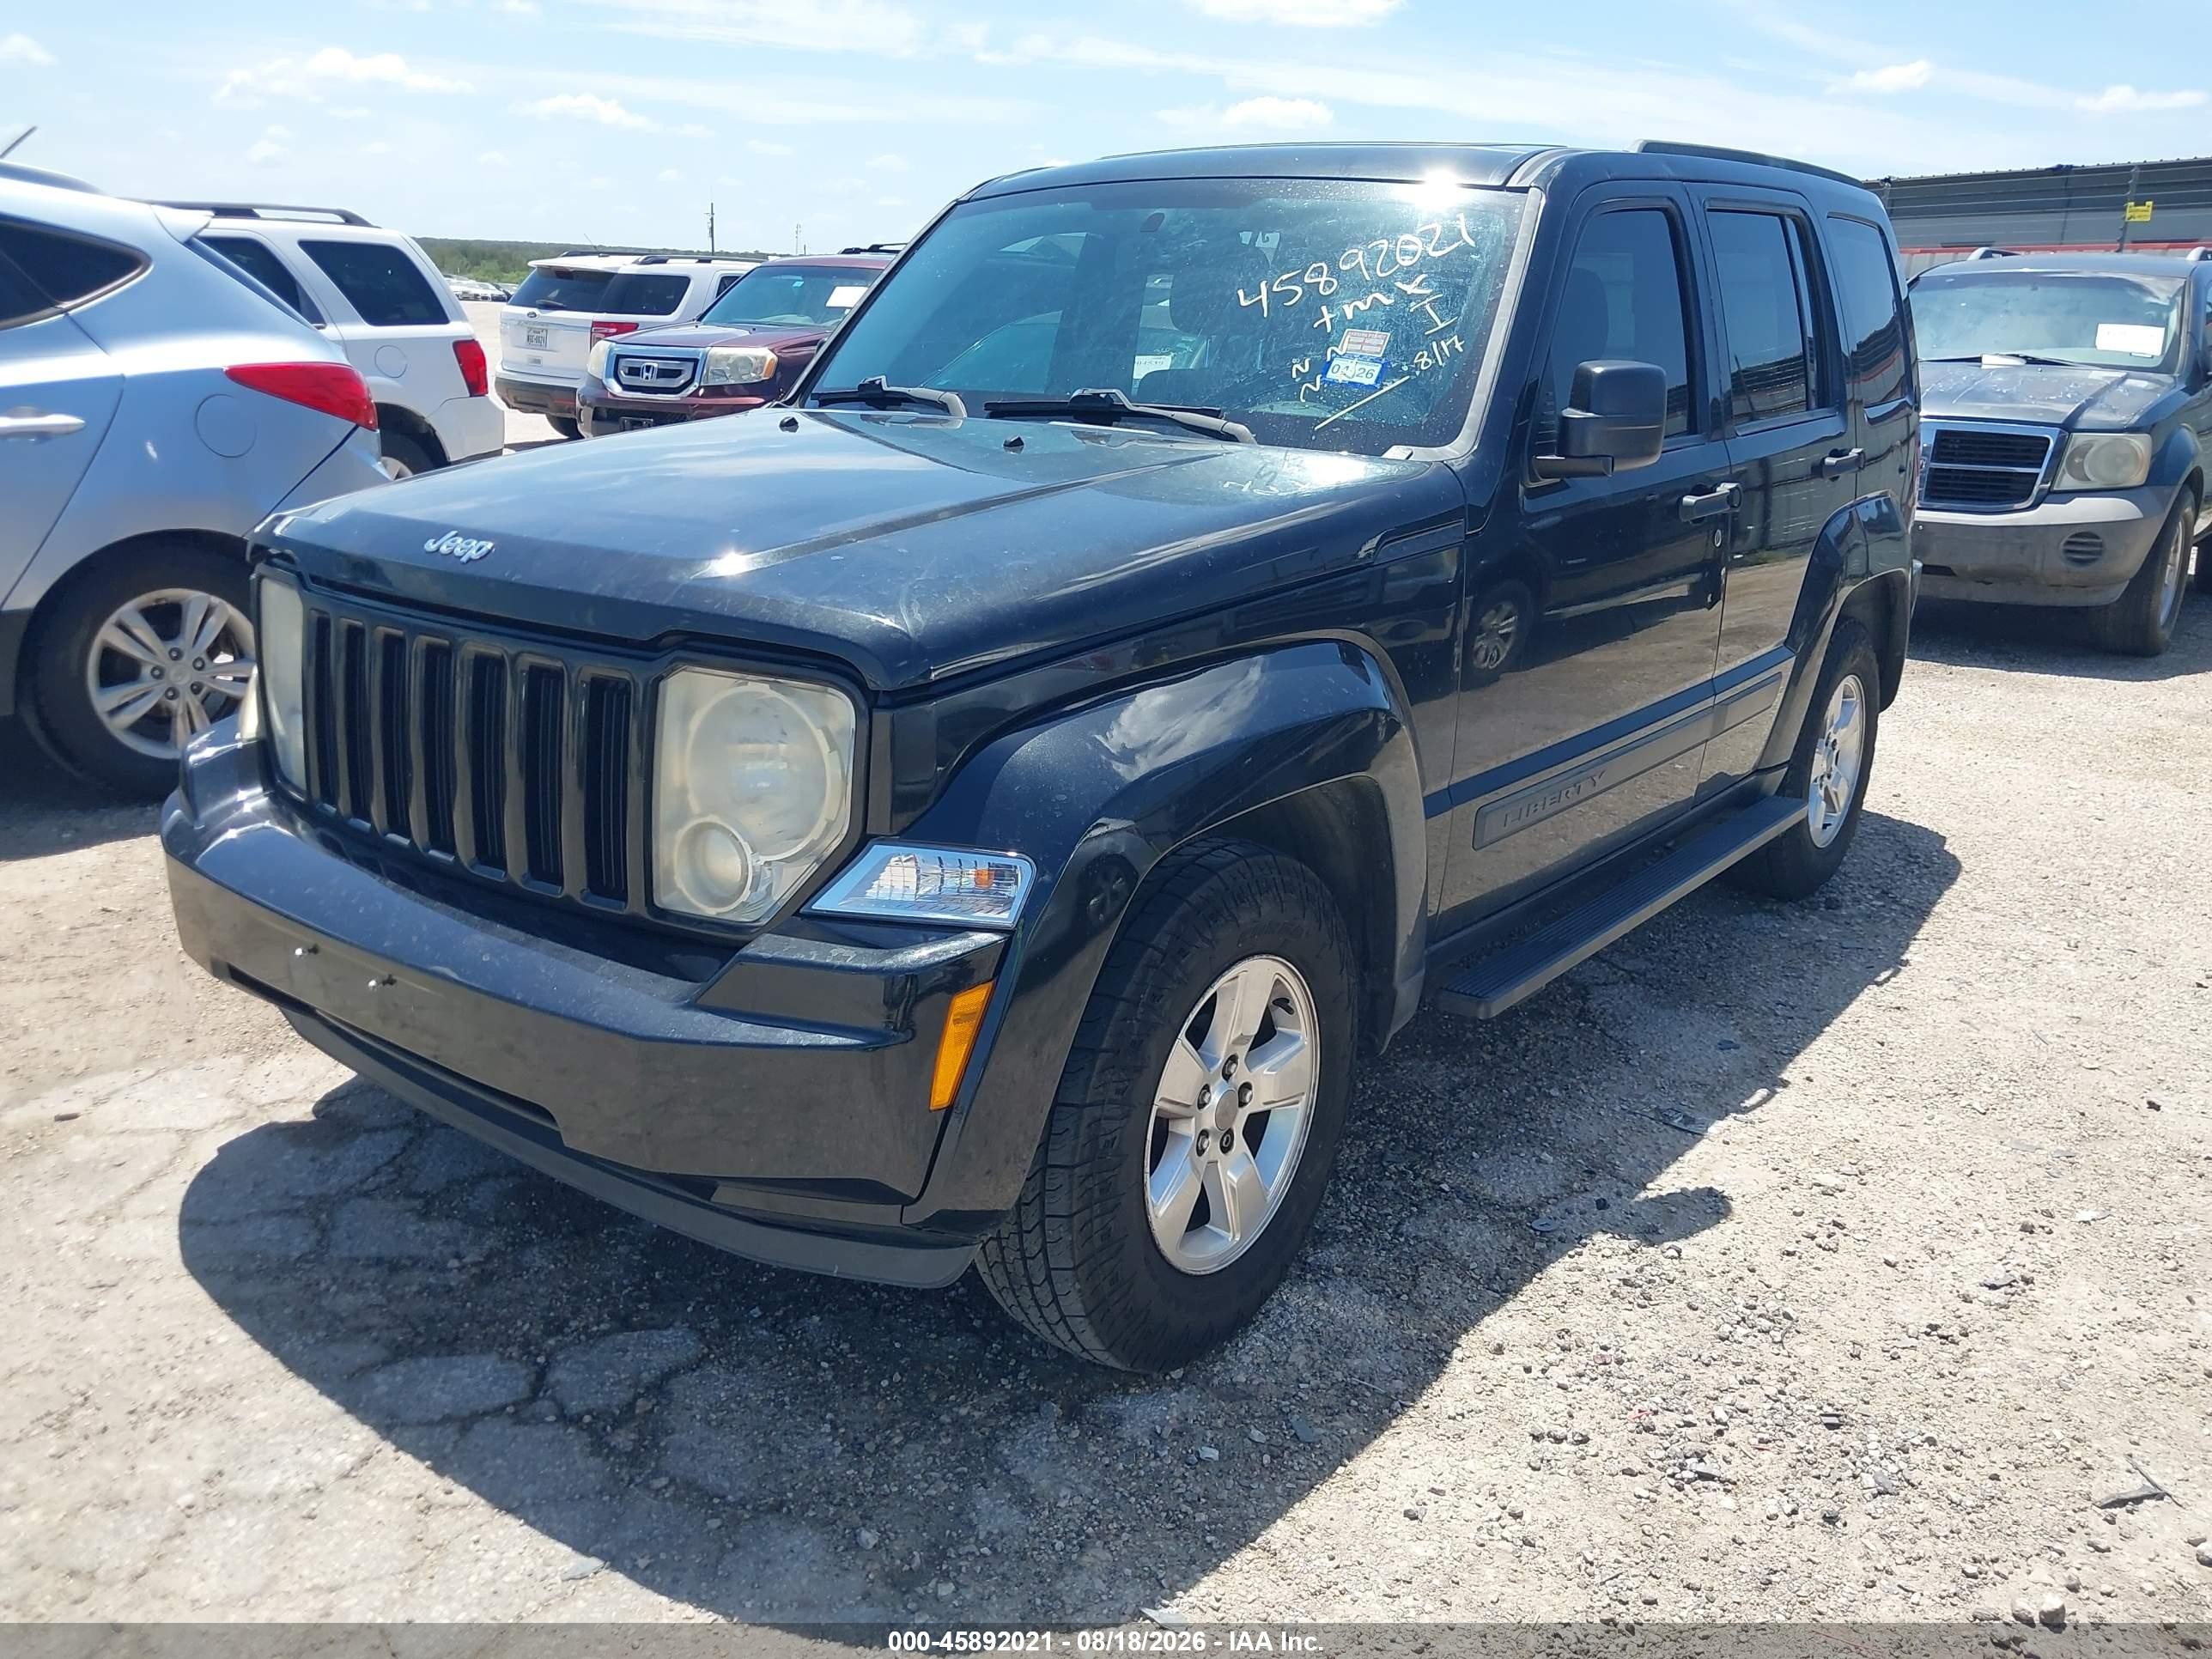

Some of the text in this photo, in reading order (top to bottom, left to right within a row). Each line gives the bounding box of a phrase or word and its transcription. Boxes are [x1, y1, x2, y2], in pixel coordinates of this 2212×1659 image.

[1237, 213, 1475, 318] 45892021
[1413, 335, 1465, 371] 8/17
[1356, 368, 1376, 379] 26
[423, 530, 495, 563] Jeep
[1504, 769, 1607, 827] LIBERTY
